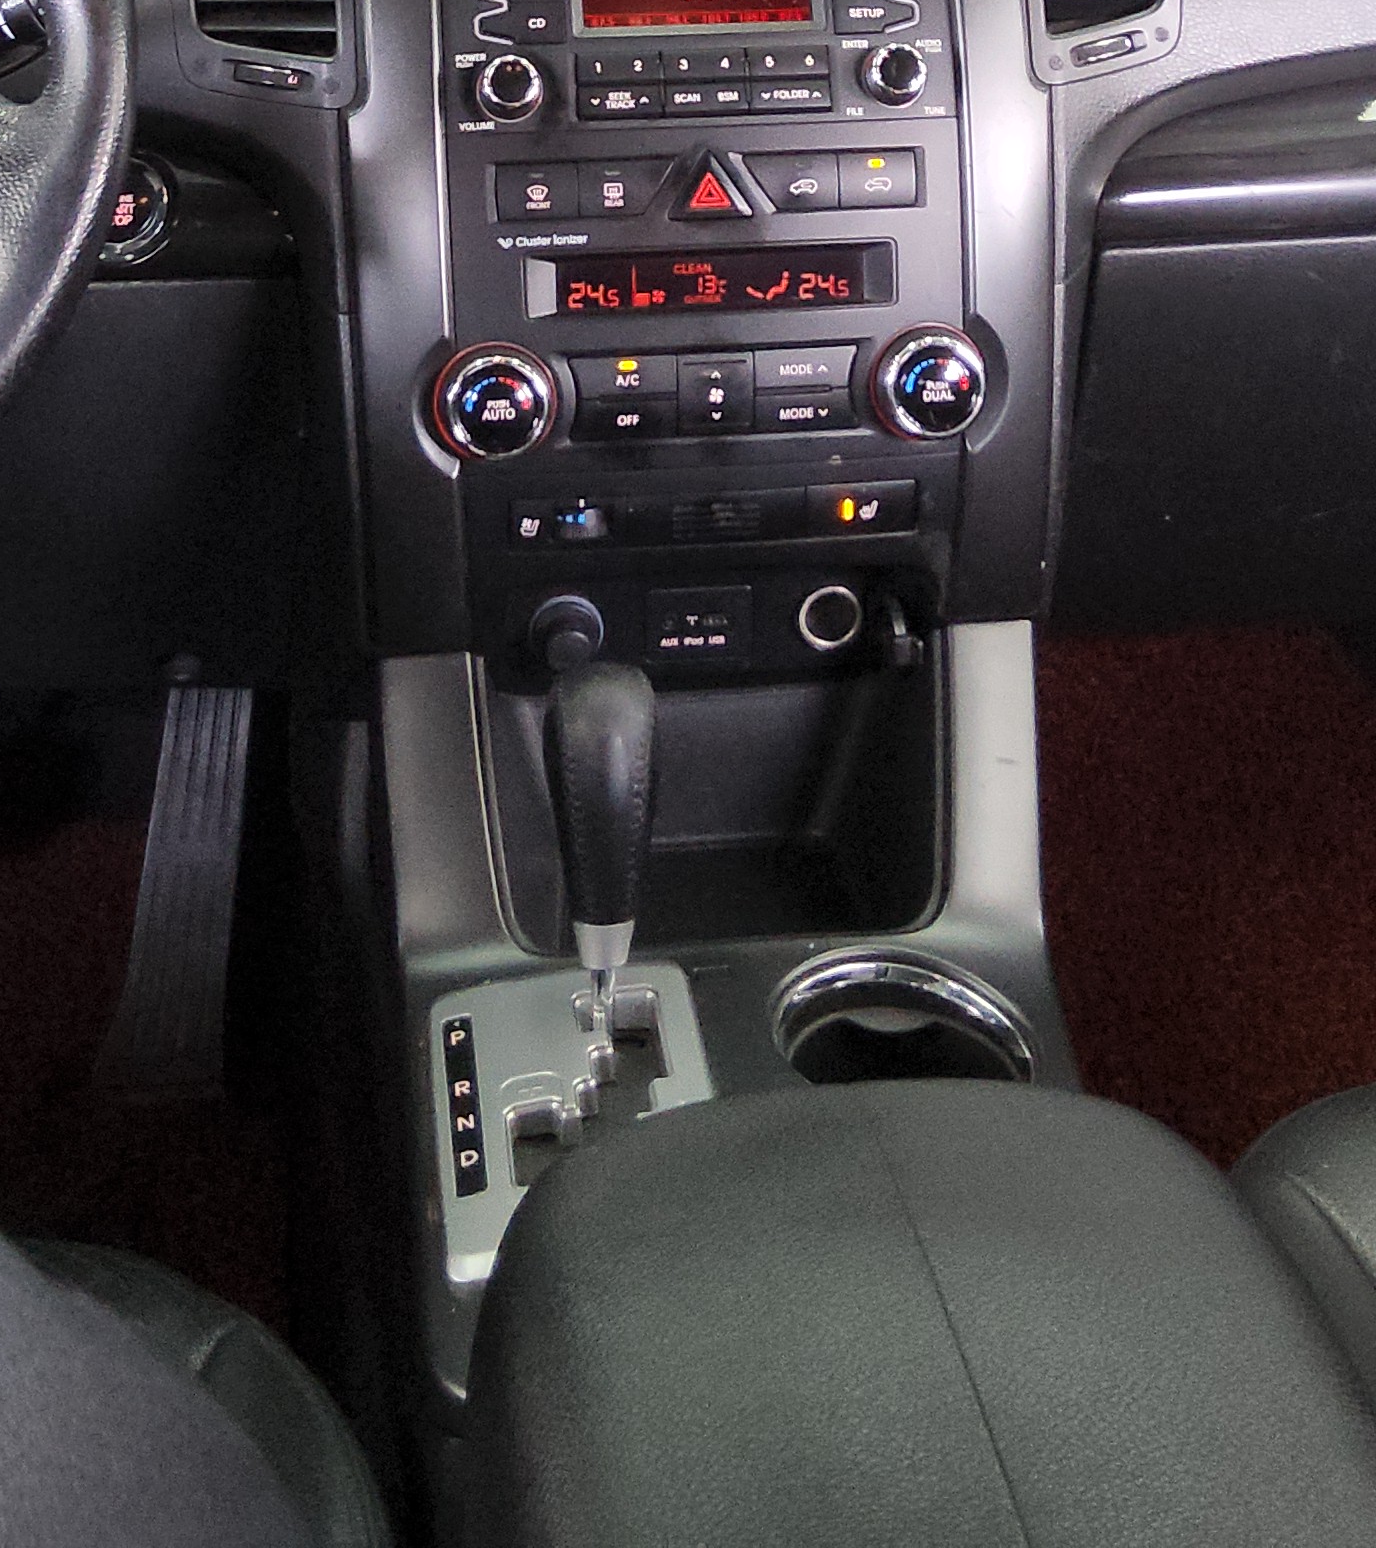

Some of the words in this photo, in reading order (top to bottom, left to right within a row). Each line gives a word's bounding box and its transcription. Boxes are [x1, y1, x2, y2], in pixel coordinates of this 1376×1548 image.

[848, 7, 885, 19] SETUP
[528, 17, 546, 29] CD
[455, 52, 487, 63] POWER
[678, 57, 689, 71] 3
[720, 56, 730, 70] 4
[765, 54, 775, 68] 5
[805, 54, 816, 67] 6
[594, 60, 602, 73] 1
[633, 59, 643, 72] 2
[674, 92, 701, 104] SCAN
[773, 88, 810, 100] FOLDER
[846, 107, 864, 116] FILE
[458, 121, 496, 131] VOLUME
[515, 235, 552, 247] Cluster
[780, 364, 813, 376] MODE
[616, 374, 640, 387] A/C
[923, 389, 955, 402] DUAL
[482, 408, 516, 421] AUTO
[779, 407, 814, 420] MODE
[616, 414, 639, 427] OFF
[450, 1031, 465, 1046] P
[454, 1080, 471, 1097] R
[457, 1114, 475, 1131] N
[460, 1149, 479, 1168] D
